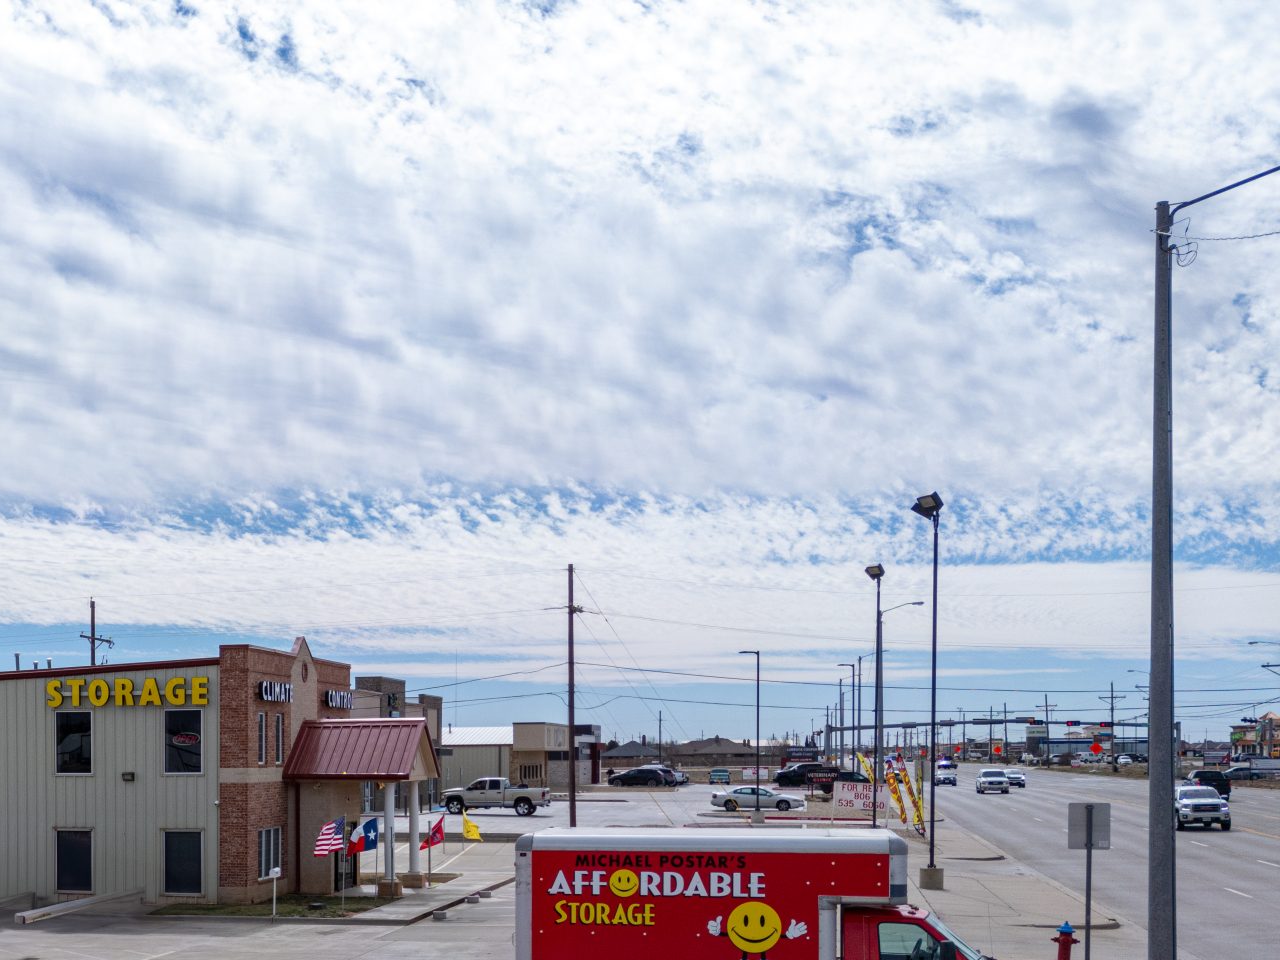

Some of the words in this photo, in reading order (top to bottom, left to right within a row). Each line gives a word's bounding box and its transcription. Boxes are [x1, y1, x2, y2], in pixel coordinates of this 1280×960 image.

[45, 676, 209, 708] STORAGE
[262, 681, 293, 703] CLIMATE
[327, 690, 354, 710] CONTROL
[175, 733, 198, 744] OPEN
[841, 783, 858, 792] FOR
[838, 799, 855, 808] 535
[854, 793, 871, 801] 806
[575, 854, 653, 868] MICHAEL
[659, 855, 747, 869] POSTAR'S
[547, 869, 766, 898] AFFORDABLE
[554, 900, 656, 926] STORAGE
